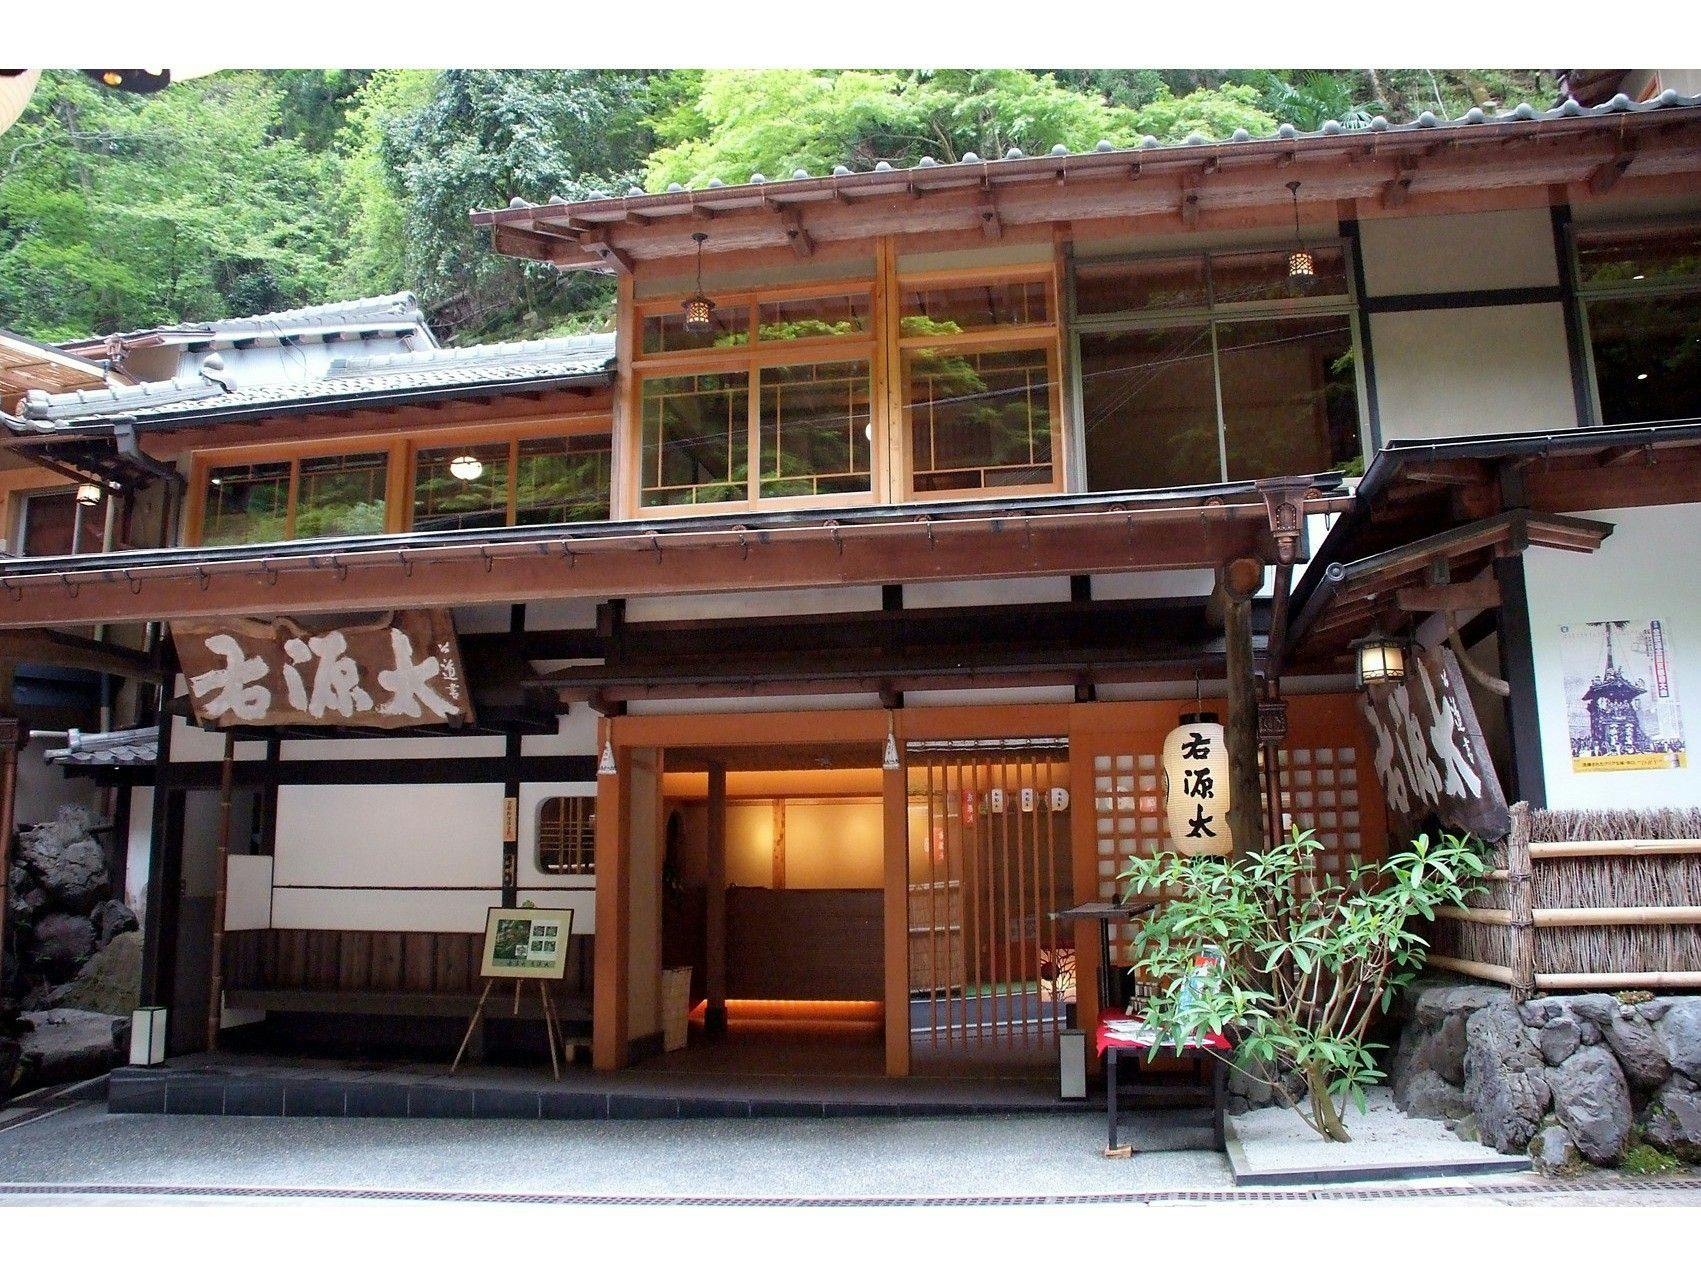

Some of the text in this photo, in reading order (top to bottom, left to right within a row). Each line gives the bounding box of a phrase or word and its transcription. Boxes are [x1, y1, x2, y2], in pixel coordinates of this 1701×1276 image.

[190, 627, 460, 720] 右源太
[1182, 732, 1216, 838] 右源太
